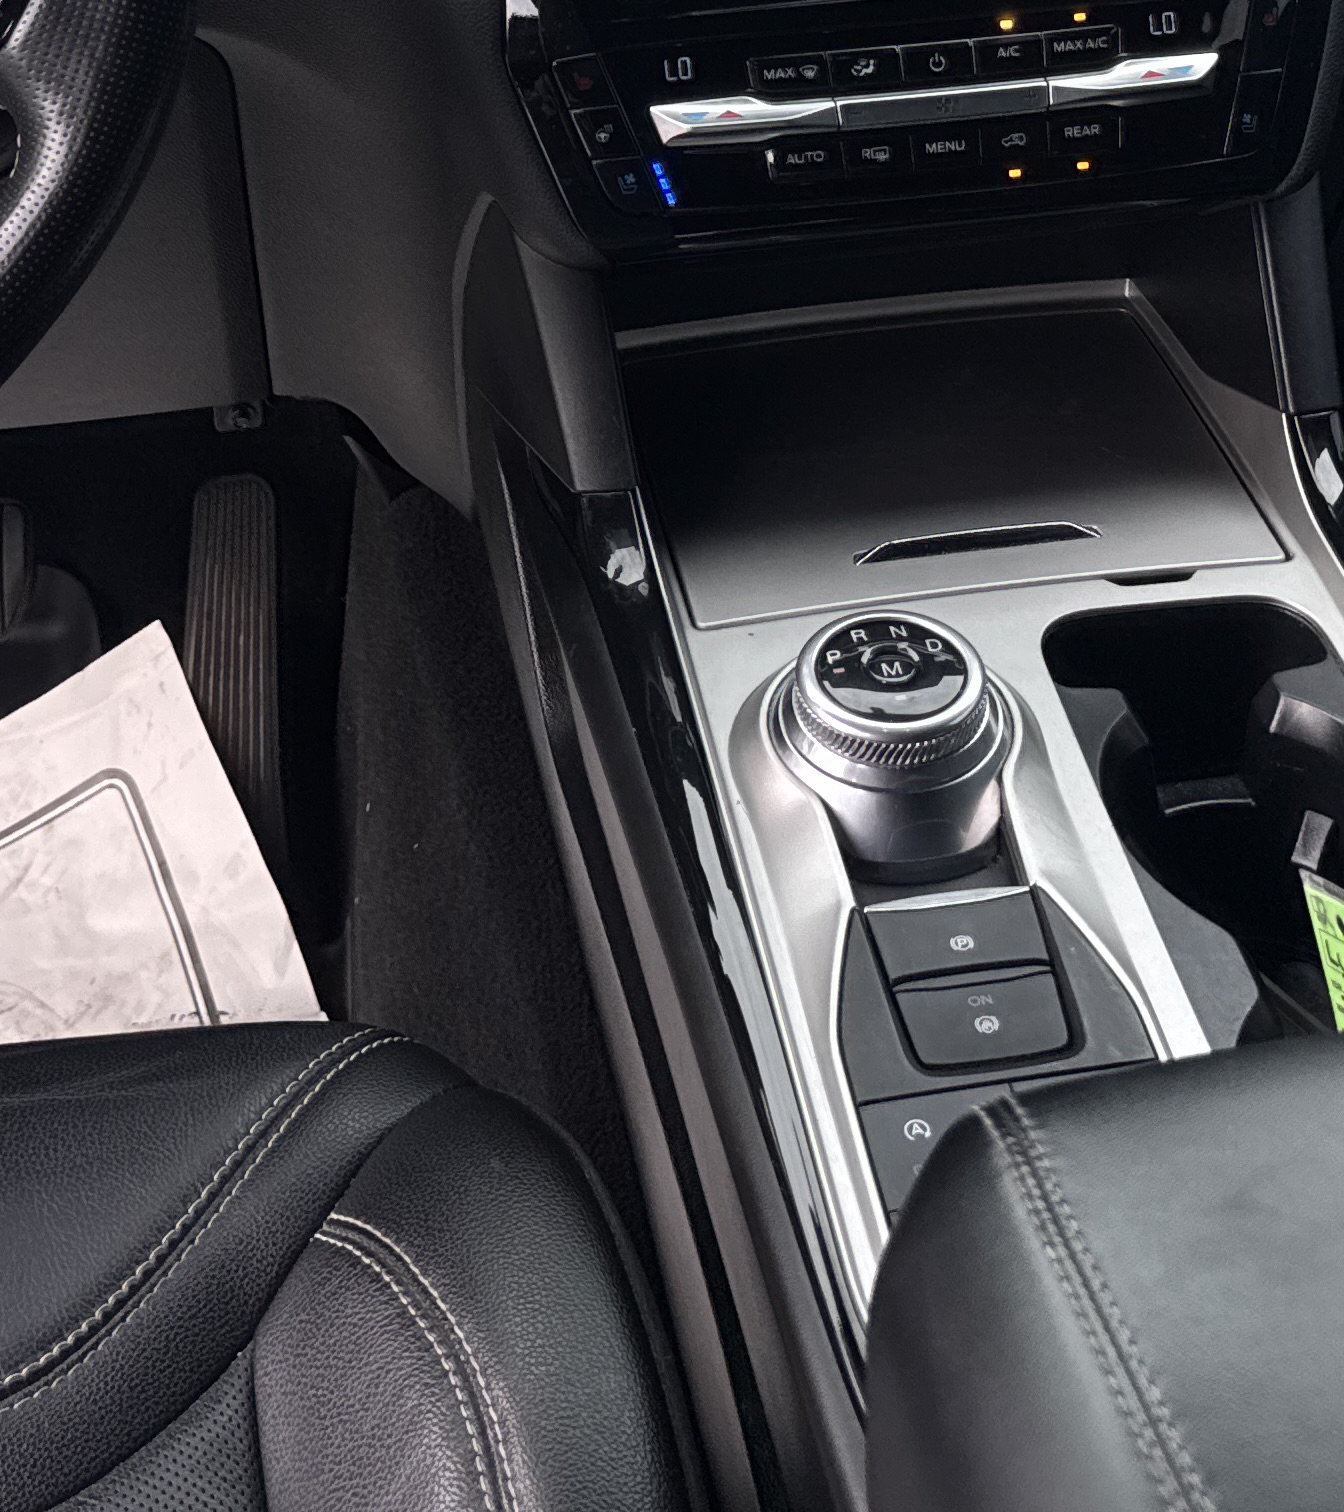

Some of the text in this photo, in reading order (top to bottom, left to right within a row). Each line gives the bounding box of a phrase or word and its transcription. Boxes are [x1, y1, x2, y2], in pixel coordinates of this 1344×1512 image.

[1149, 10, 1178, 36] LO
[997, 44, 1021, 59] A/C
[1053, 36, 1108, 53] MAX A/C
[664, 55, 692, 82] LO
[762, 66, 796, 80] MAX
[1064, 123, 1101, 138] REAR
[925, 138, 966, 154] MENU
[786, 149, 825, 165] AUTO
[850, 628, 869, 644] R
[889, 624, 909, 639] N
[924, 638, 943, 653] D
[826, 650, 843, 665] P
[880, 661, 904, 677] M
[967, 993, 994, 1008] ON
